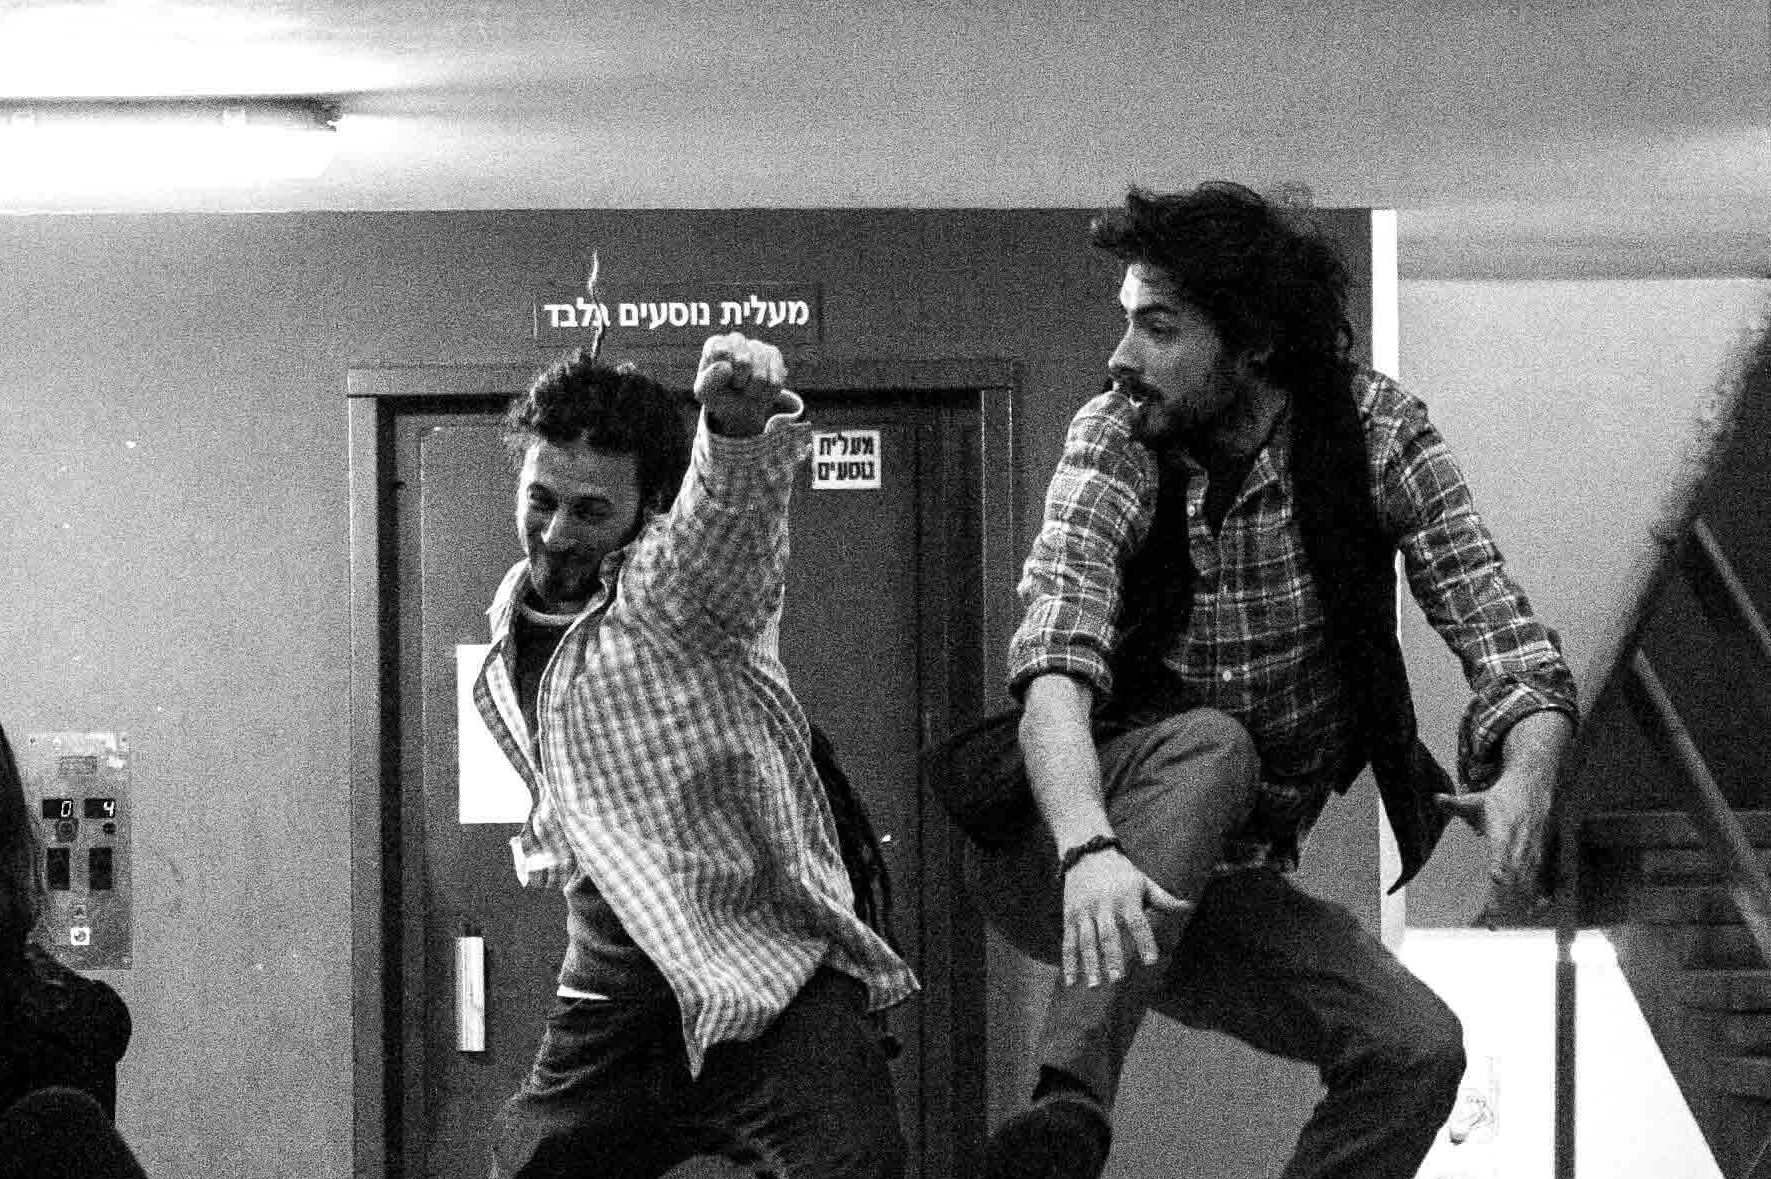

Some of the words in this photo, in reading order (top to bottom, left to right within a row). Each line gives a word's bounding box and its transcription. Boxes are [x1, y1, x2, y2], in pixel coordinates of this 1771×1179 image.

[543, 297, 611, 328] בלבד
[619, 302, 711, 329] נוסעים
[720, 295, 810, 328] מעלית
[820, 434, 874, 456] מעלית
[818, 461, 875, 481] נוסעים
[103, 800, 115, 817] 4
